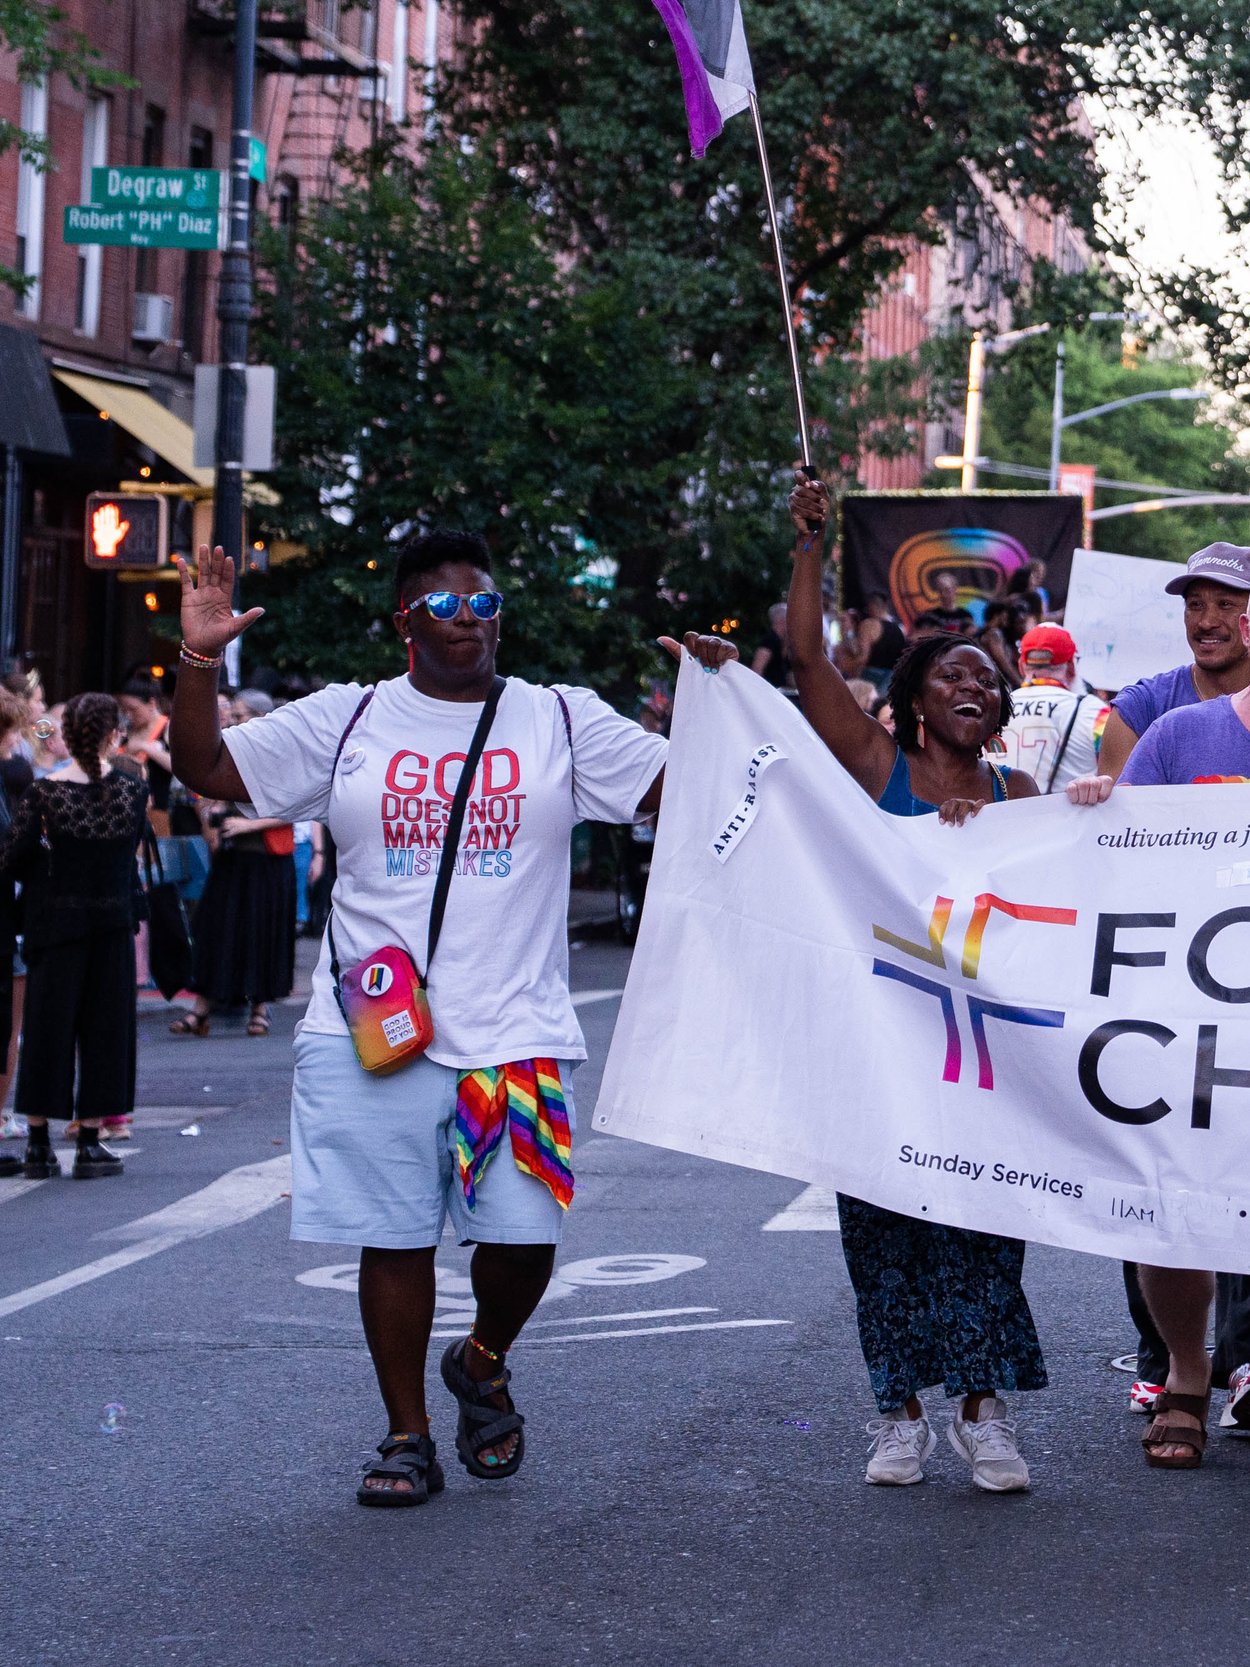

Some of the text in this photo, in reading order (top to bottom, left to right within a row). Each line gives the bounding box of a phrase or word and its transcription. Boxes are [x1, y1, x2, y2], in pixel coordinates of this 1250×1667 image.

[107, 169, 207, 205] Degraw St
[68, 207, 213, 235] Robert "PH" Diaz
[1189, 553, 1245, 572] Mammoths
[1013, 700, 1058, 718] CKEY
[384, 748, 521, 800] GOD
[468, 794, 526, 825] NOT
[713, 745, 777, 855] ANTI-RACIST
[463, 823, 521, 850] ANY
[1097, 827, 1217, 850] cultivating
[1223, 831, 1238, 844] a
[384, 1014, 409, 1030] GOD IS
[386, 1021, 411, 1036] PROUD
[399, 1027, 414, 1038] YOU
[898, 1145, 985, 1181] Sunday
[991, 1163, 1084, 1199] Services
[1111, 1197, 1154, 1223] 11AM
